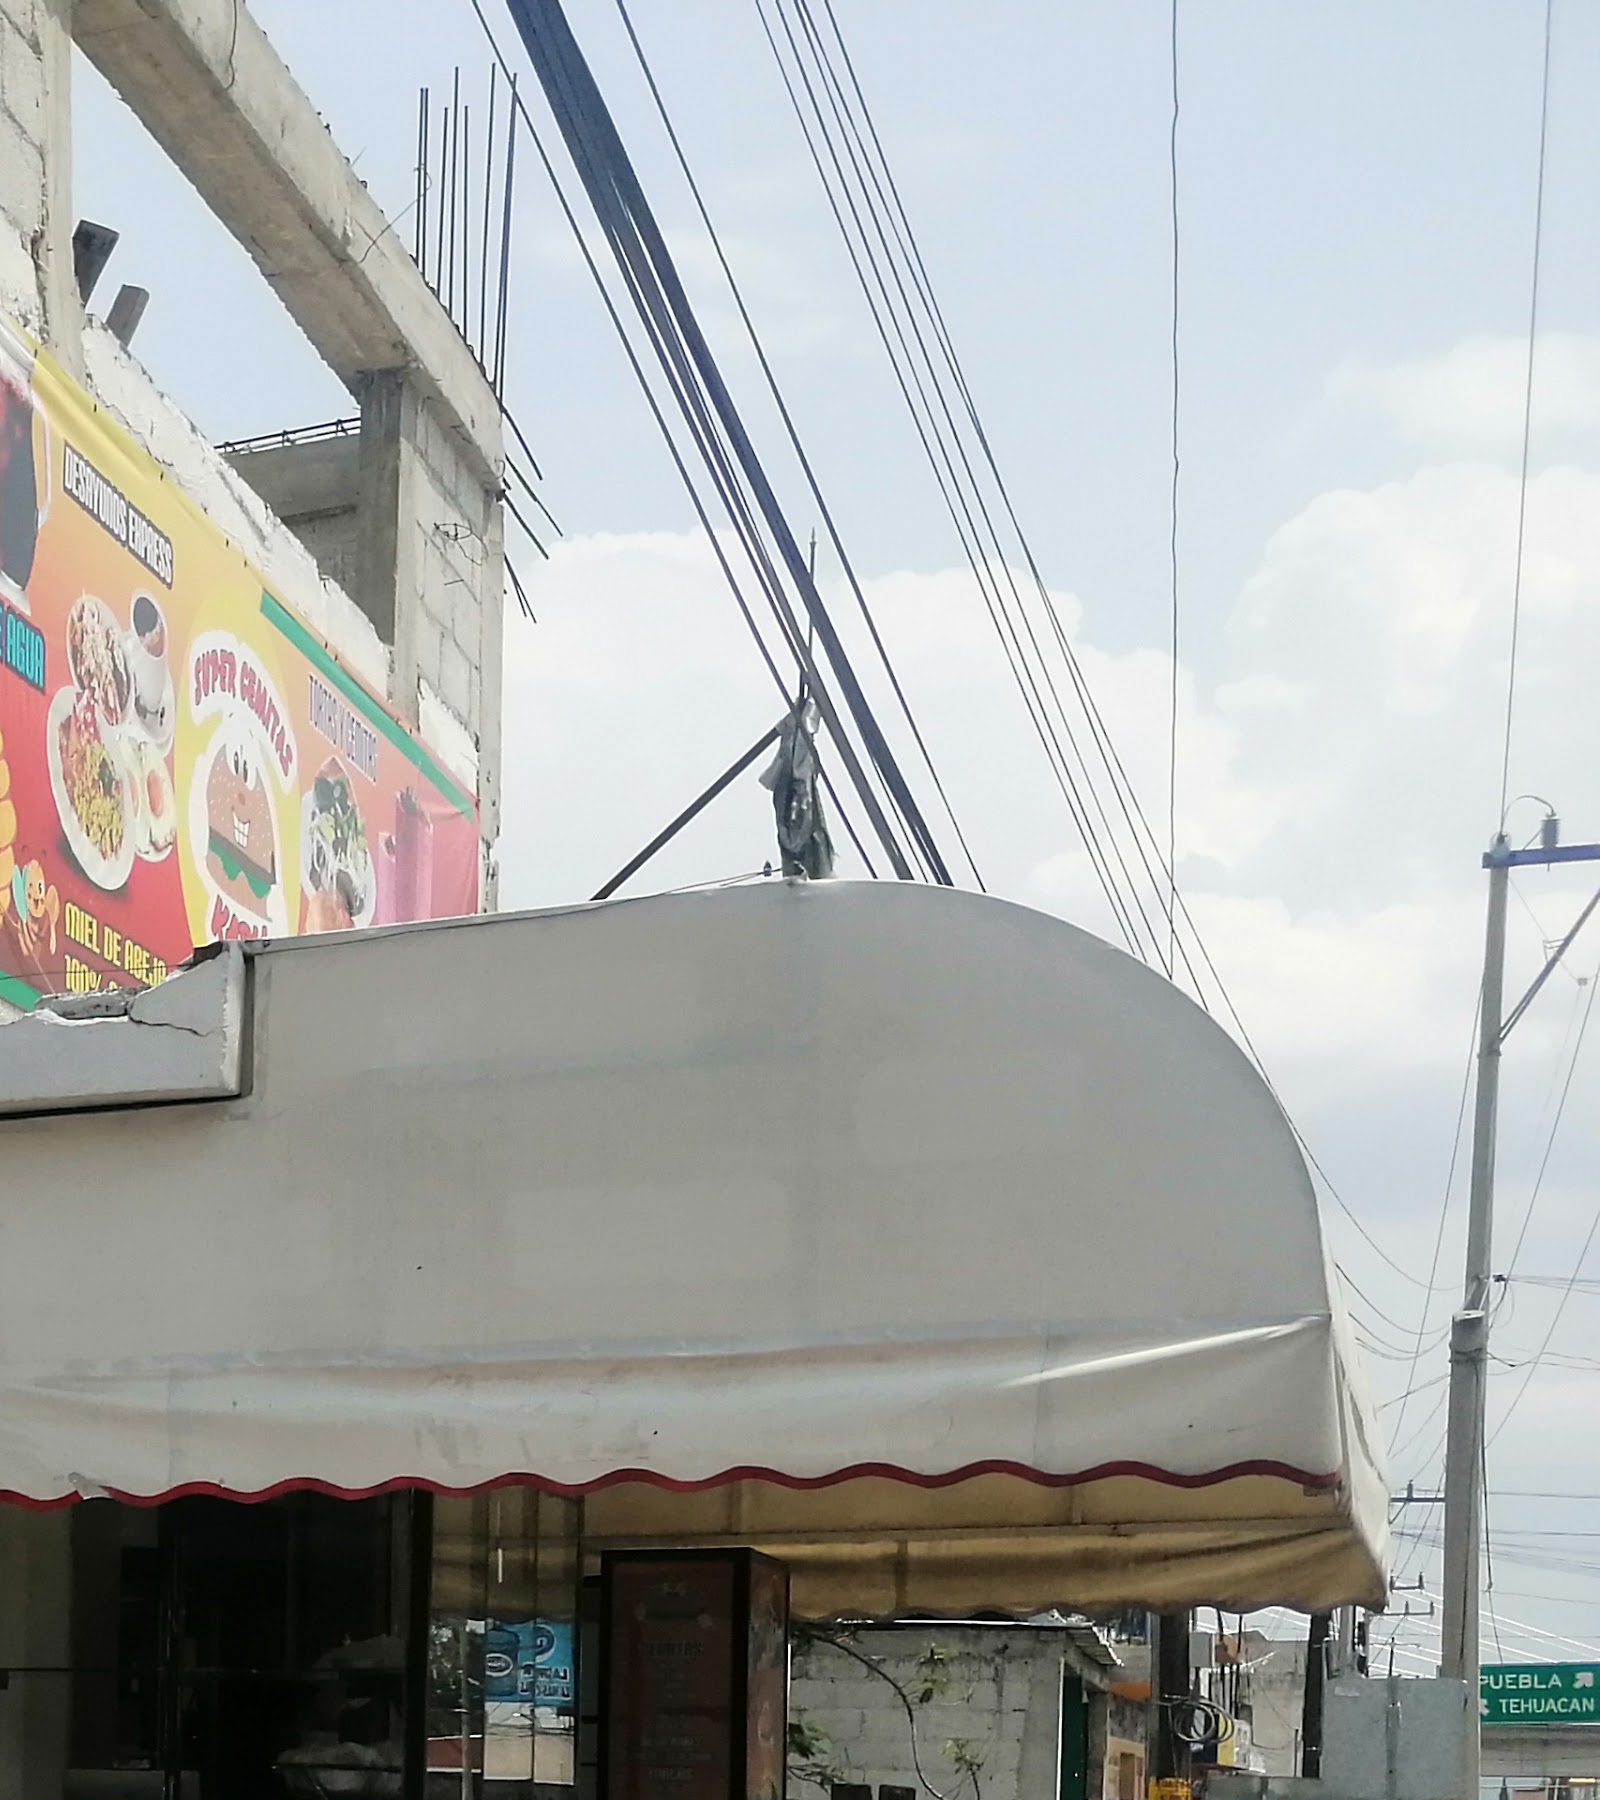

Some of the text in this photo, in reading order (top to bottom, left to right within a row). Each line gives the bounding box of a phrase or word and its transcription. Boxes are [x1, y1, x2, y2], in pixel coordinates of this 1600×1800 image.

[65, 446, 172, 584] DESAYUNOS EXPRESS
[7, 613, 45, 688] AGUA
[195, 648, 236, 706] SUPER
[65, 903, 166, 987] MIEL DE ABEJA
[1499, 1697, 1594, 1713] TEHUACAN
